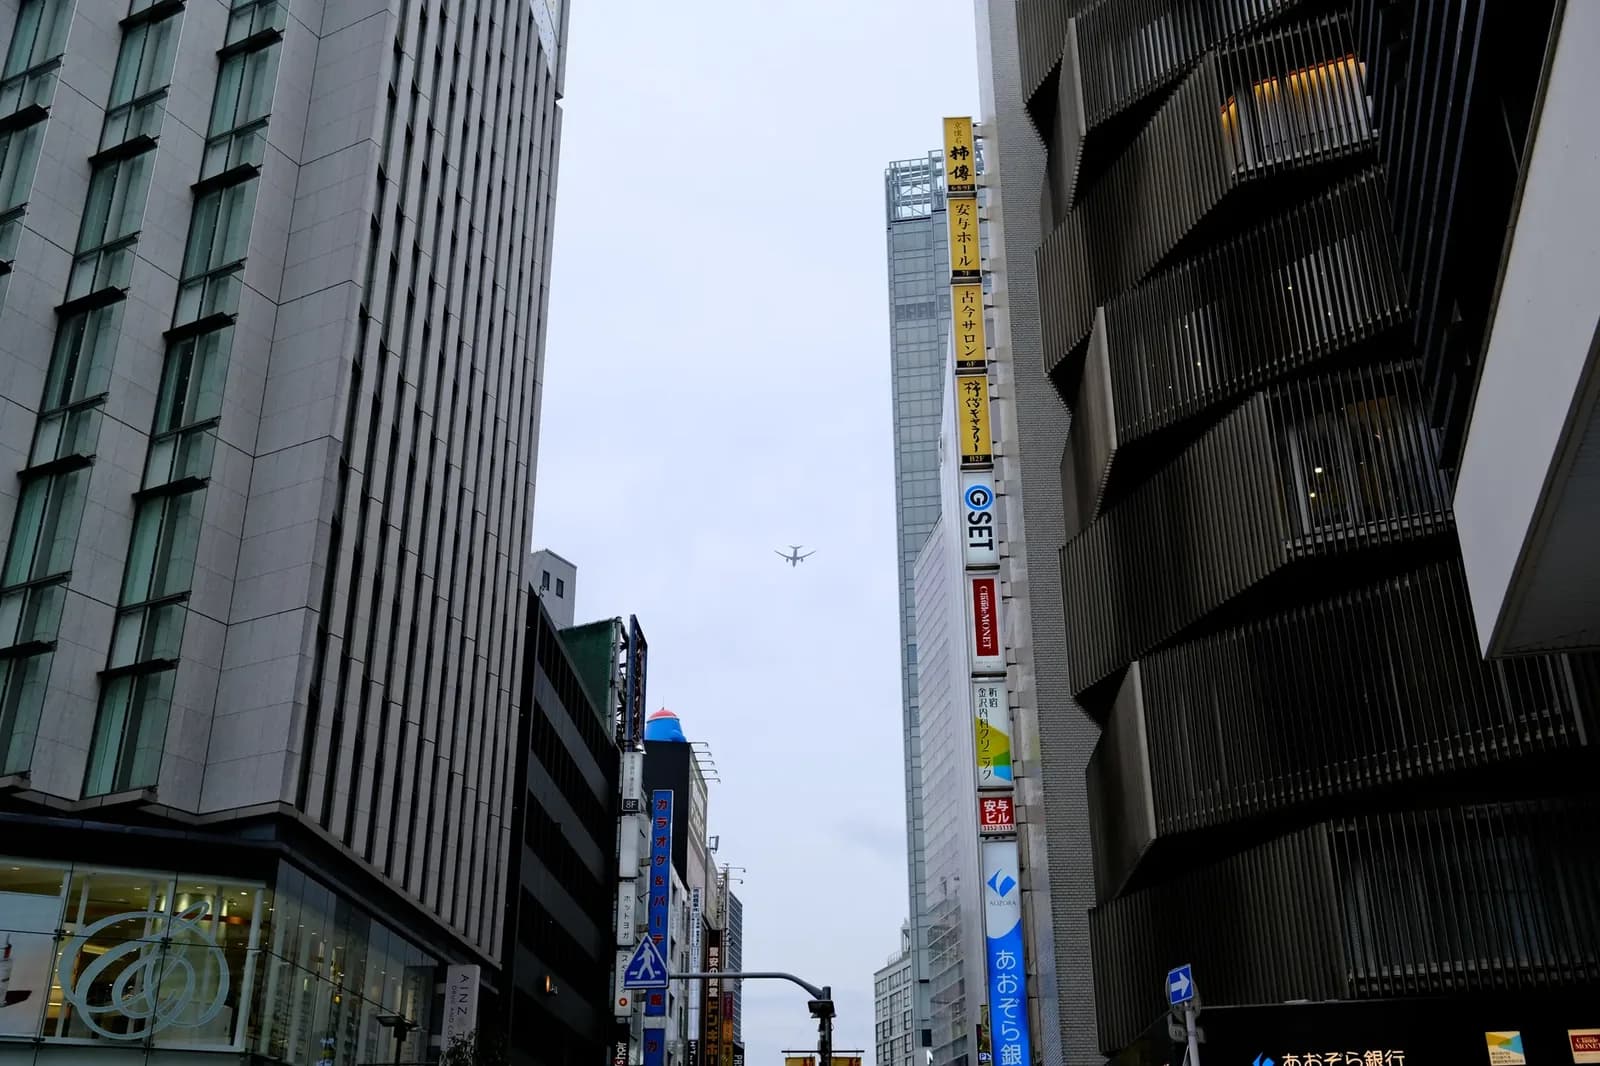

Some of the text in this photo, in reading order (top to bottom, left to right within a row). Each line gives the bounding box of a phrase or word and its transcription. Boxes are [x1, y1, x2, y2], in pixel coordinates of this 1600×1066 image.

[956, 203, 973, 266] 安与ホール
[961, 290, 976, 357] 古今サロン
[966, 486, 993, 551] GSET
[981, 613, 992, 649] MONET
[989, 687, 998, 708] 新宿
[978, 687, 991, 780] 金沢内科クリニック
[625, 801, 637, 809] 8F
[984, 800, 1009, 812] 安与
[986, 812, 1010, 824] ビル
[623, 895, 631, 939] ホットヨガ
[457, 974, 470, 1016] AINZ
[1282, 1050, 1405, 1066] あおぞら銀行
